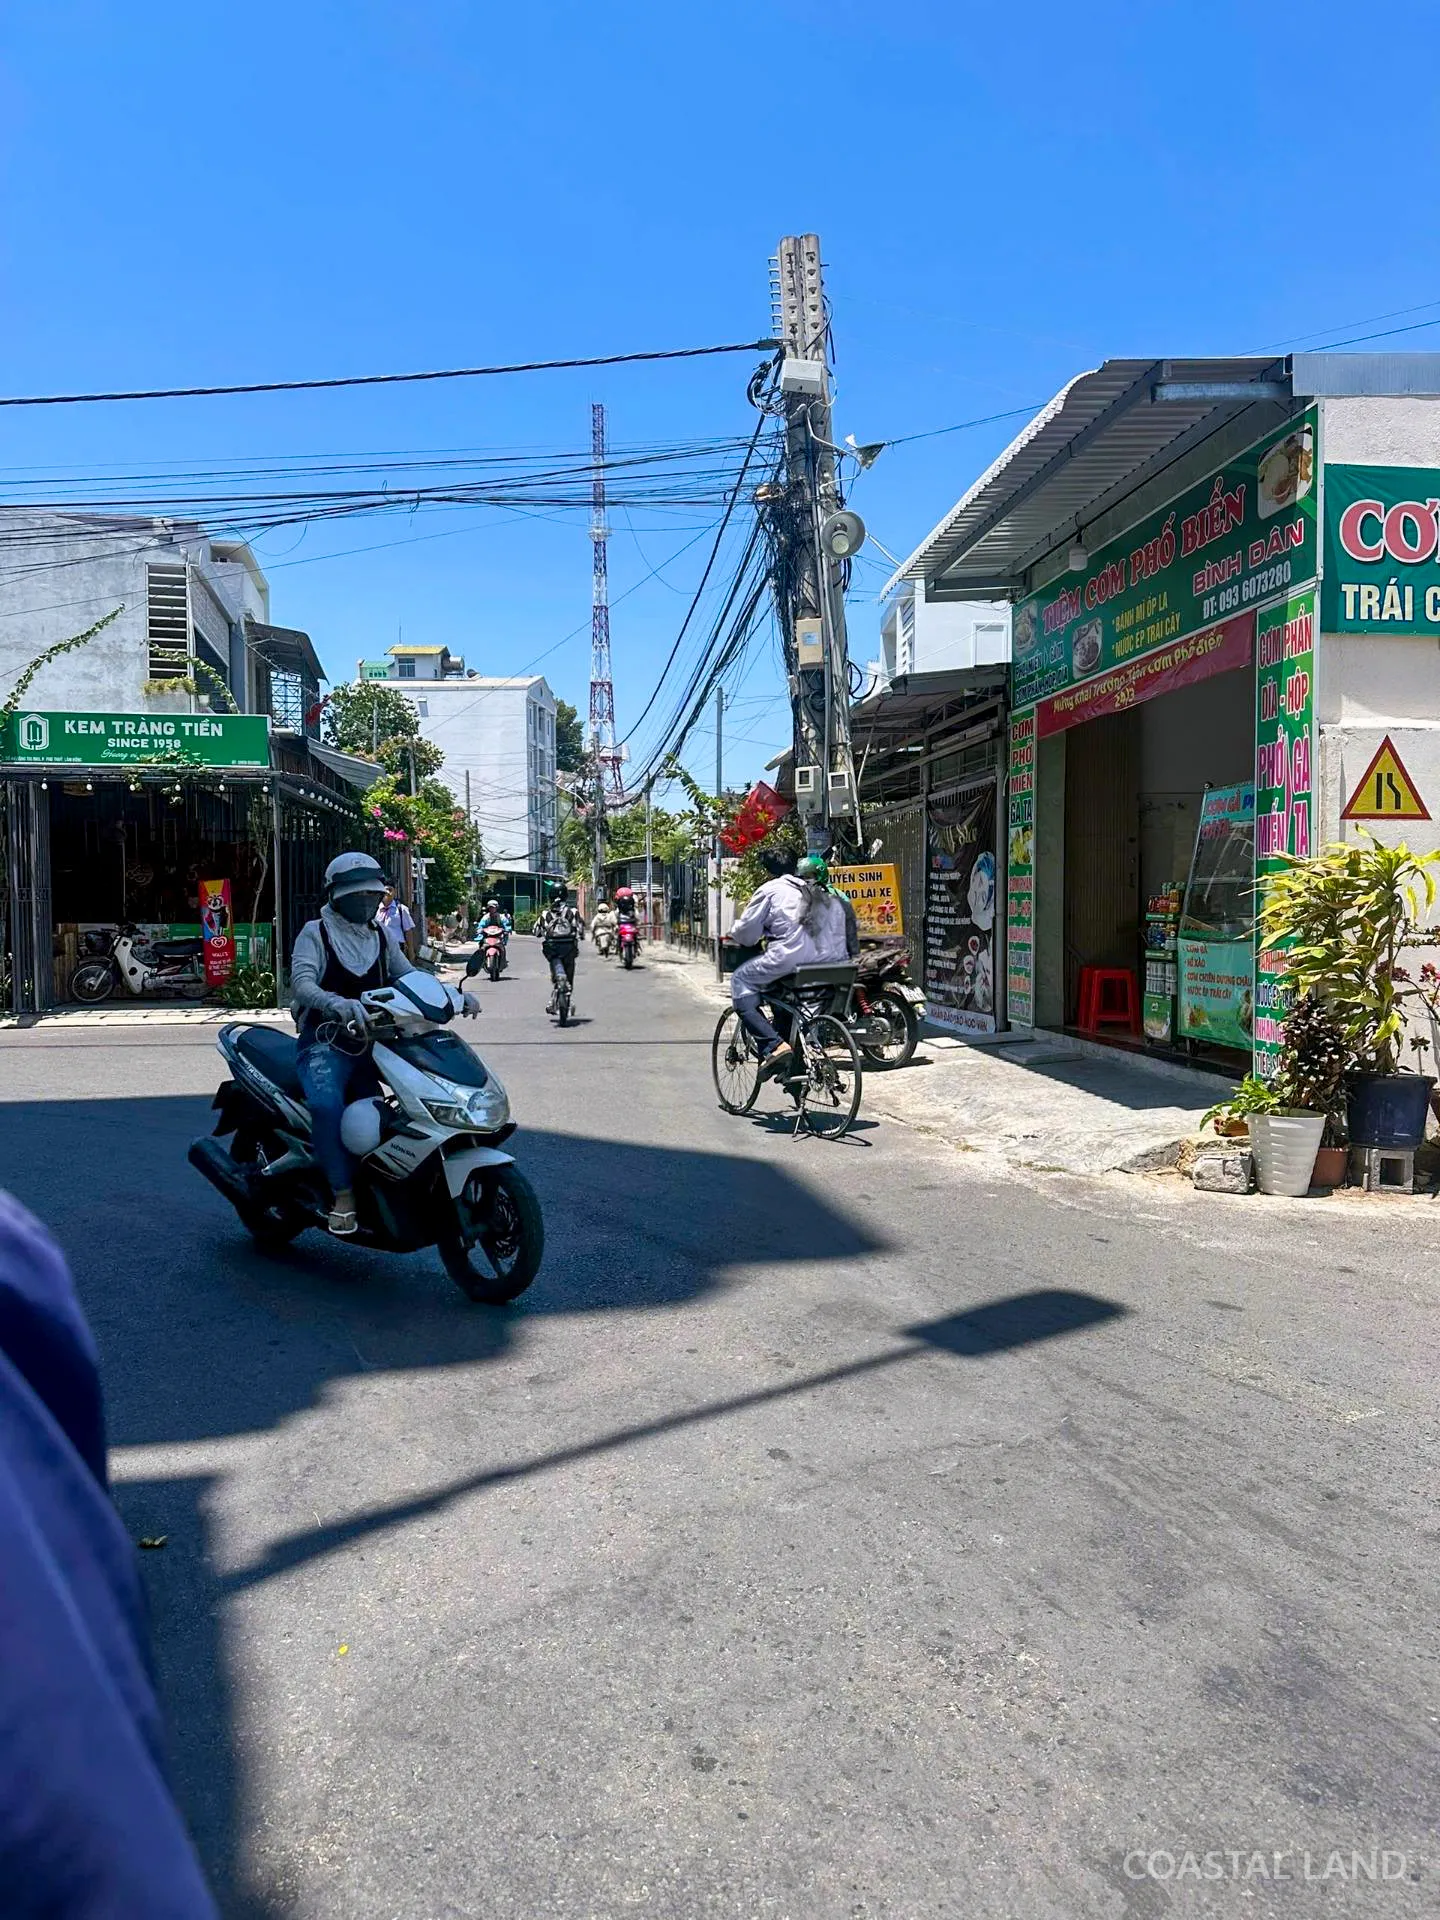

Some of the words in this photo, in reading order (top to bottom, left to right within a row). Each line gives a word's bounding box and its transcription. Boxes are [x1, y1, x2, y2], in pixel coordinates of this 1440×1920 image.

[1339, 498, 1440, 564] CƠ
[1085, 558, 1126, 611] CƠM
[1130, 511, 1176, 587] PHỐ
[1193, 551, 1242, 597] BÌNH
[1248, 518, 1304, 569] DÂN
[1219, 584, 1239, 612] 093
[1242, 560, 1291, 602] 6073280
[1341, 578, 1413, 621] TRÁI
[1259, 625, 1282, 669] CƠM
[1286, 665, 1310, 721] HỘP
[64, 719, 106, 735] KEM
[111, 717, 176, 736] TRÀNG
[108, 738, 149, 749] SINCE
[153, 738, 182, 749] 1958
[1012, 718, 1034, 742] CƠM
[1258, 723, 1285, 791] PHỞ
[1023, 798, 1033, 823] TA
[858, 871, 883, 882] SINH
[879, 887, 892, 897] XE
